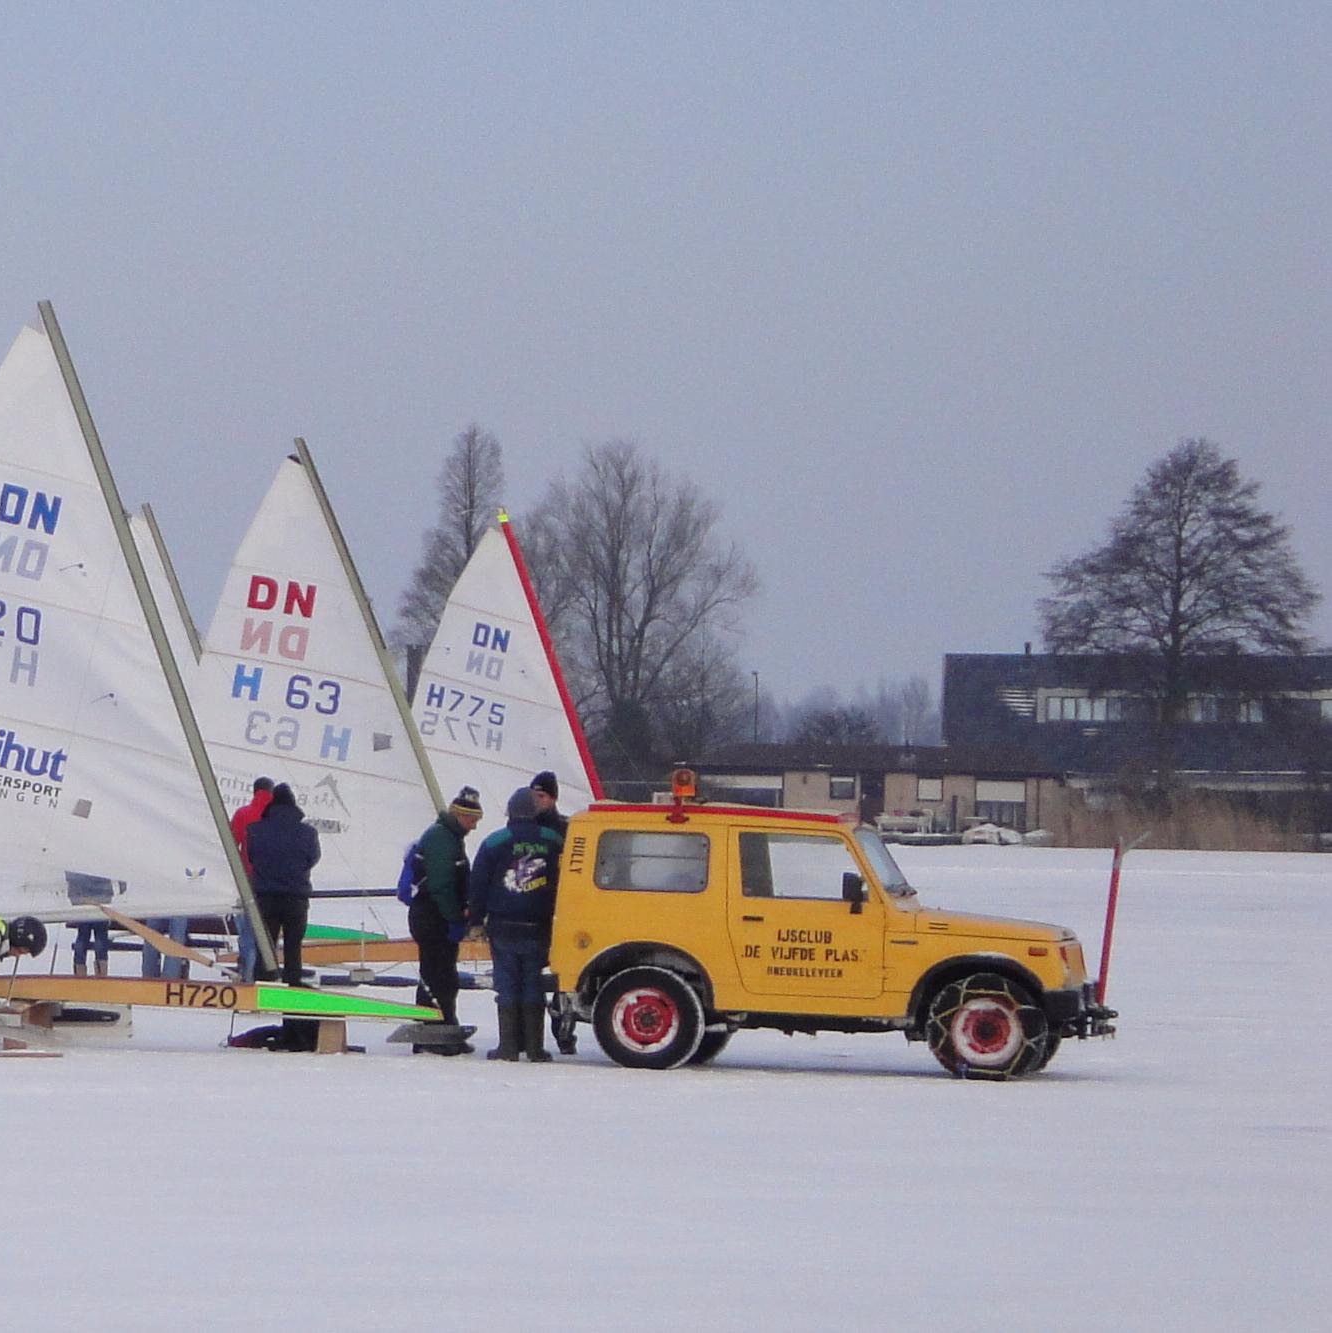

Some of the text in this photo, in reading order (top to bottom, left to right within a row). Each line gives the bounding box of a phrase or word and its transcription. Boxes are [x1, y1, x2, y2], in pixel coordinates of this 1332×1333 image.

[247, 575, 317, 619] DN
[472, 622, 511, 653] DN
[232, 664, 341, 715] H 63
[425, 683, 506, 726] H775
[569, 836, 586, 874] BULLY
[772, 946, 816, 961] VIJFDE
[777, 929, 832, 944] IJSCLUB
[166, 984, 238, 1008] H720
